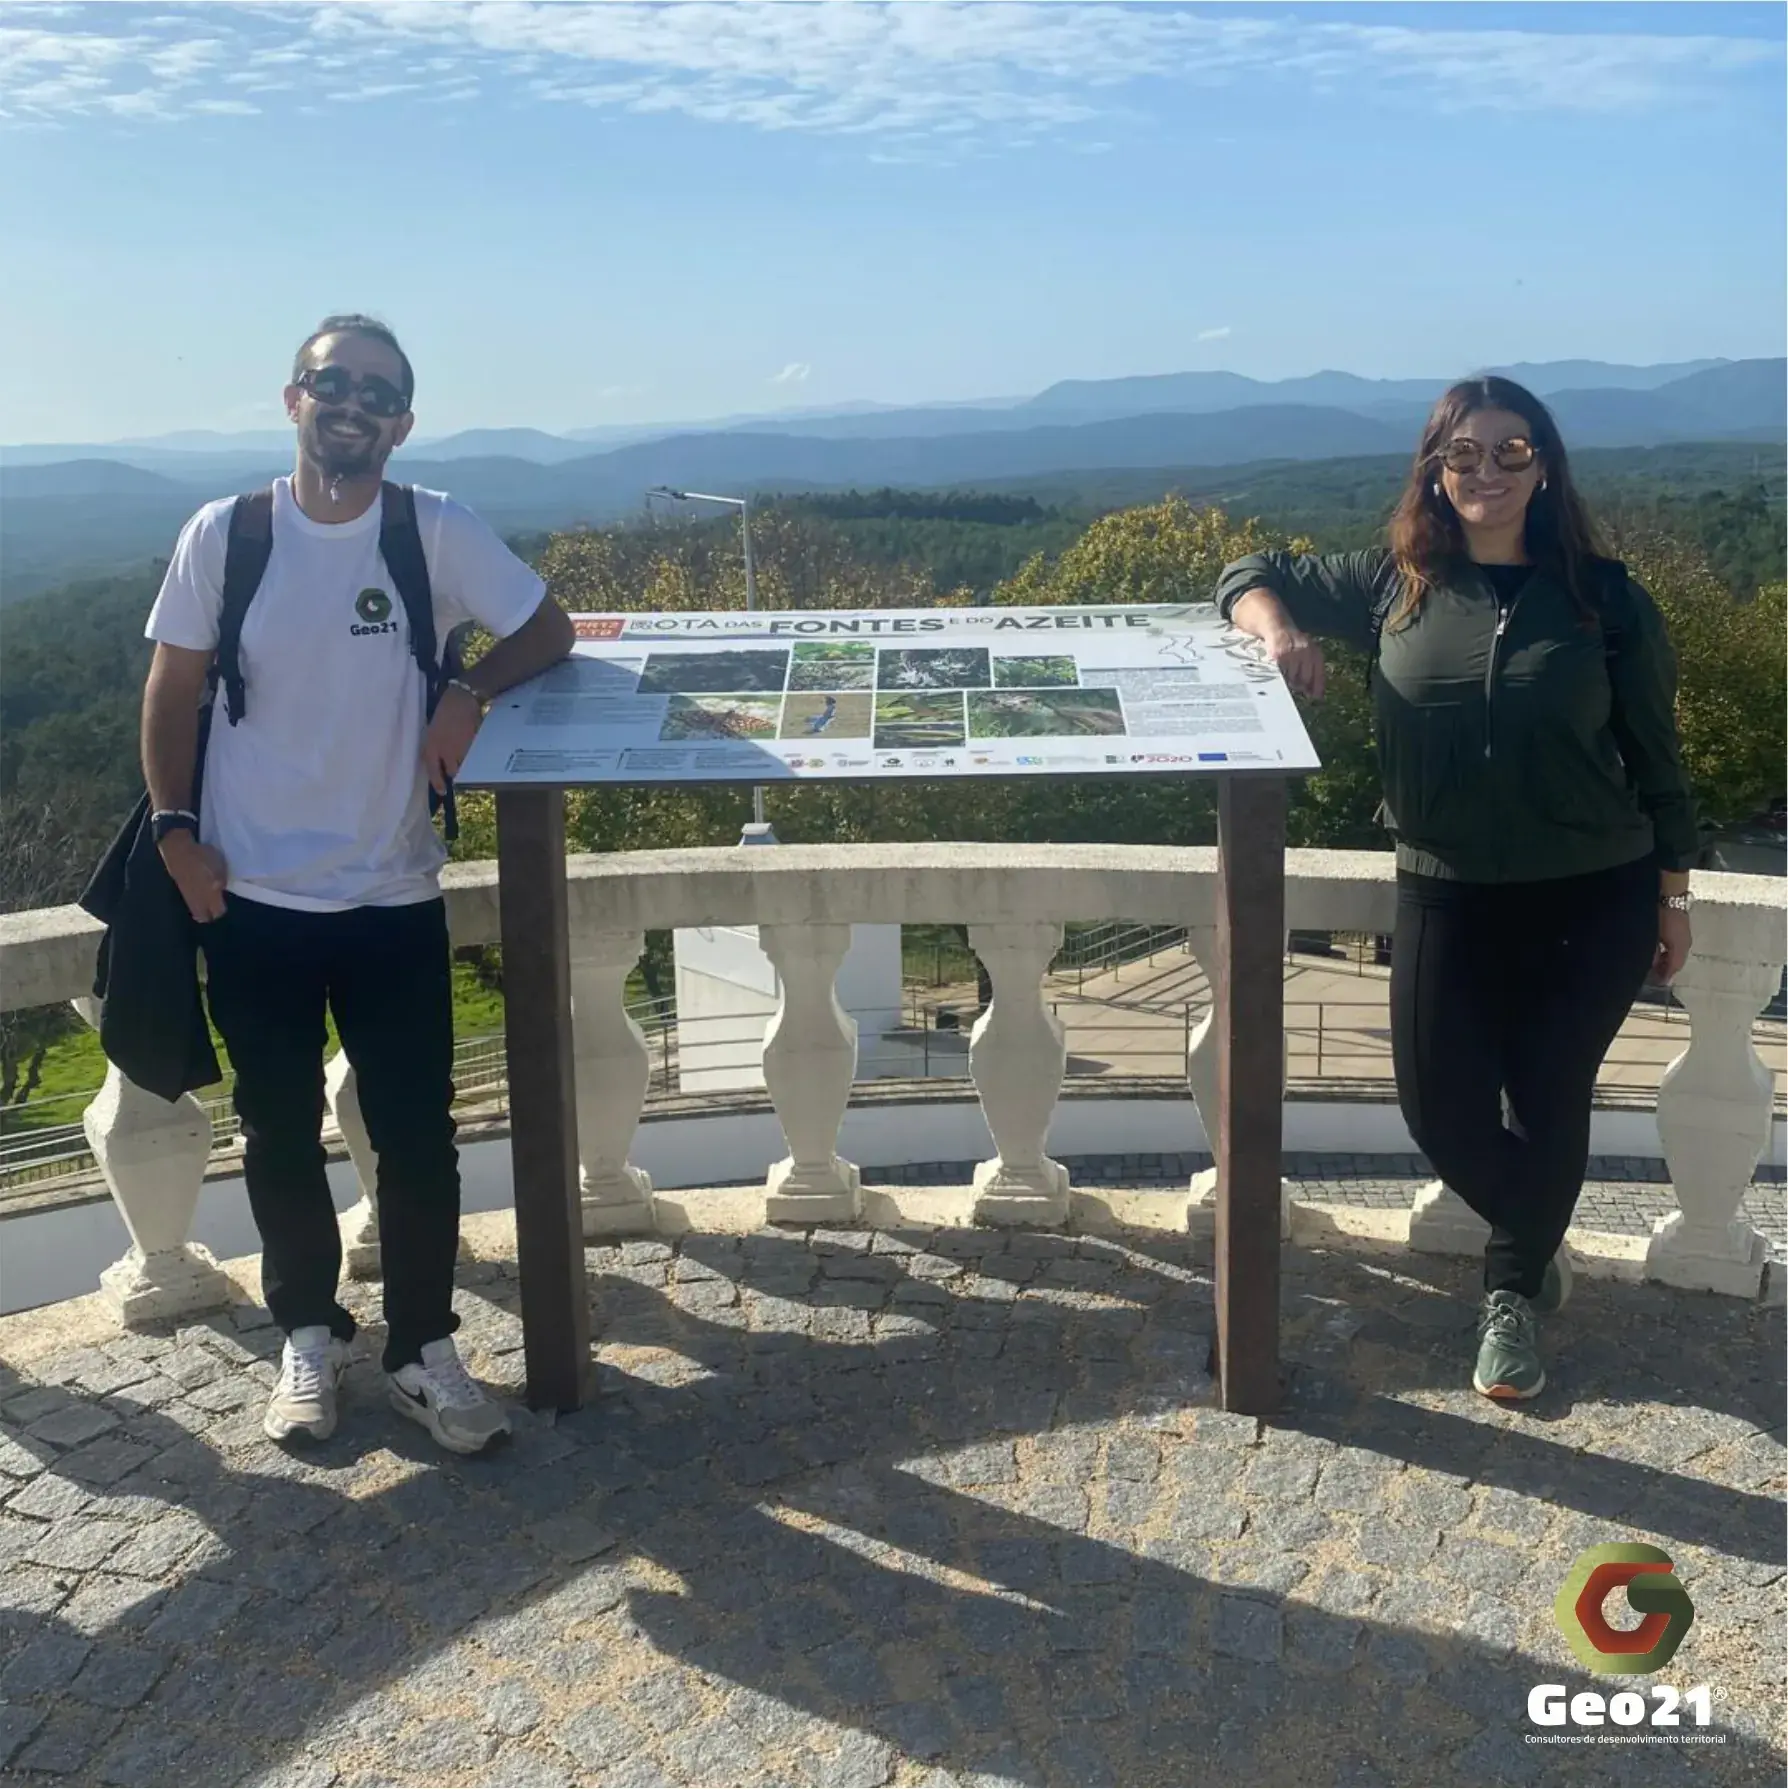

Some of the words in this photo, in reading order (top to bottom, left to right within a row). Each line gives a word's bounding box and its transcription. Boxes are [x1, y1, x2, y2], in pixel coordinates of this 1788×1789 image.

[350, 622, 398, 636] Geo21
[724, 620, 763, 629] DAS
[769, 618, 945, 634] FONTES
[966, 616, 993, 624] DO
[994, 614, 1151, 630] AZEITE
